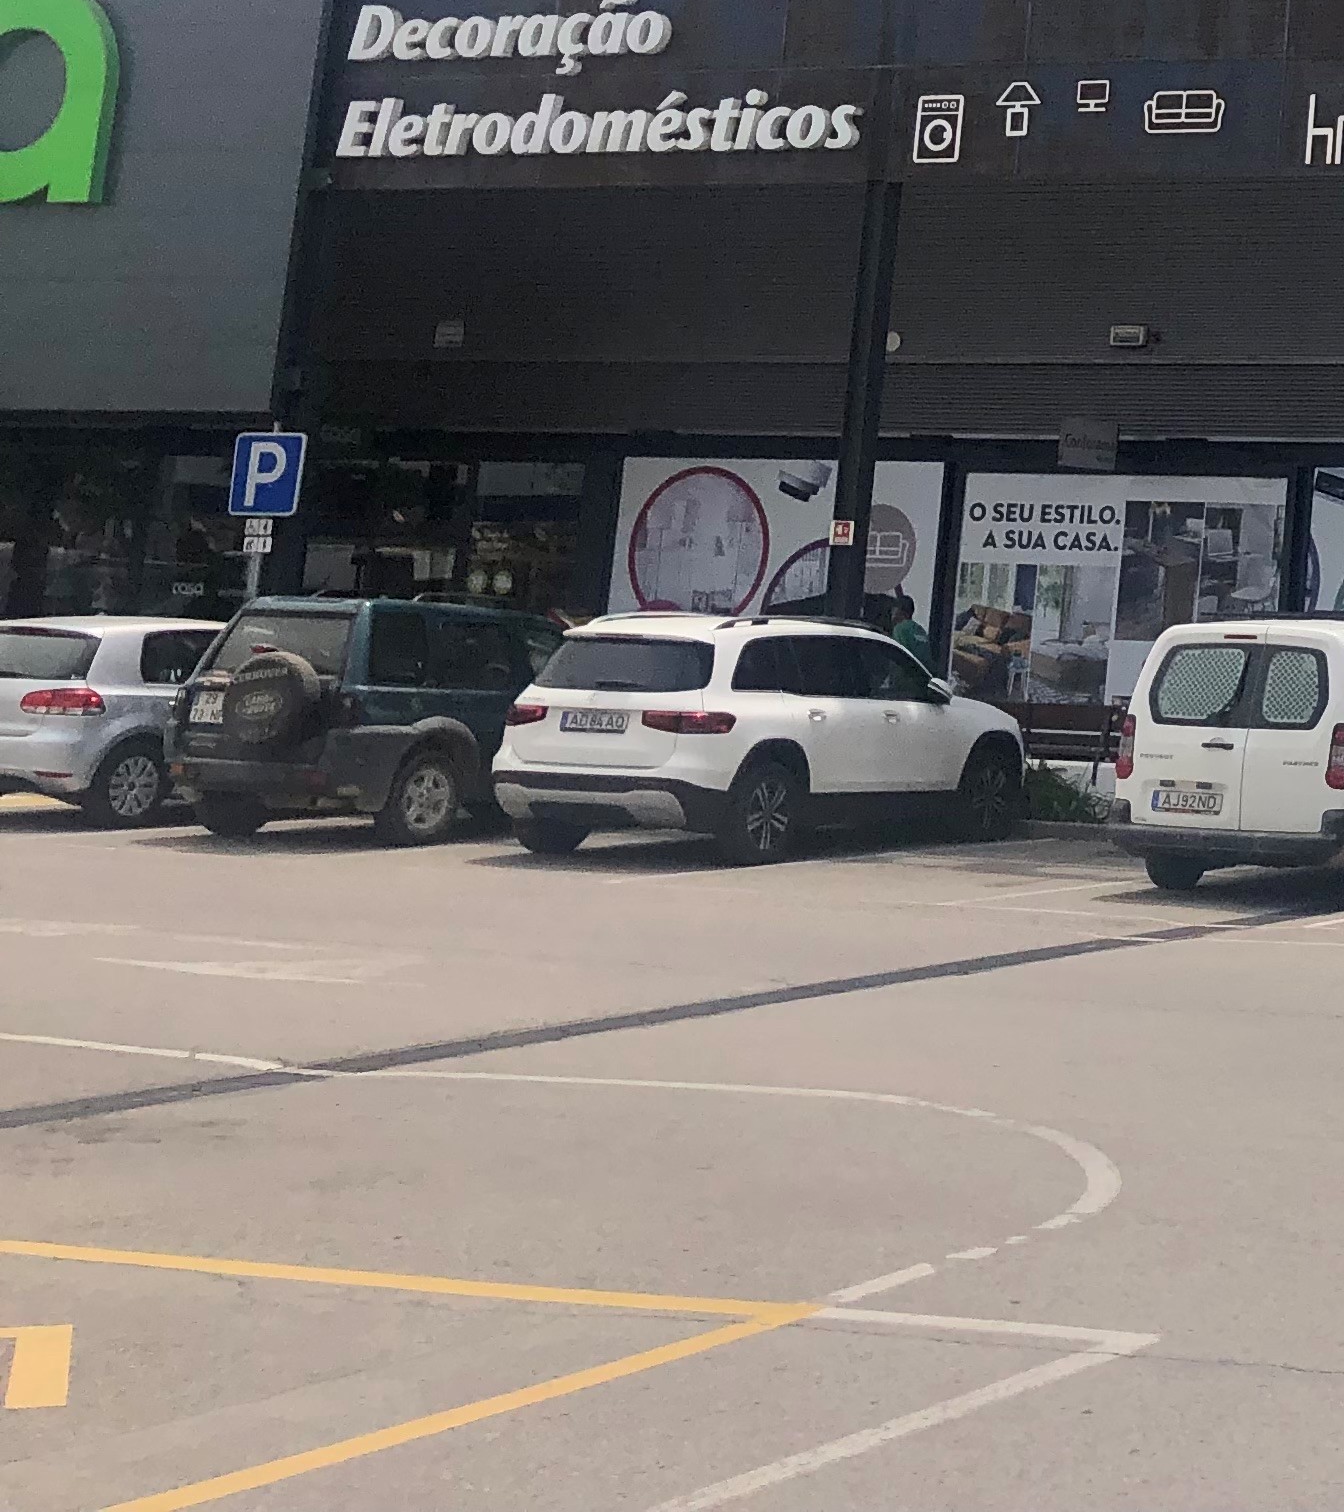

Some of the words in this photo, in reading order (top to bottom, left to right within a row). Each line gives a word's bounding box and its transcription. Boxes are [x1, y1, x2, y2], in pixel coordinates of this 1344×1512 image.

[336, 88, 864, 158] Eletrodomésticos
[243, 441, 287, 507] P
[968, 502, 987, 522] O
[992, 502, 1035, 523] SEU
[1040, 503, 1121, 525] ESTILO.
[982, 529, 998, 548] A
[1003, 529, 1047, 550] SUA
[1053, 530, 1119, 552] CASA.
[1161, 793, 1217, 809] AJ92ND
